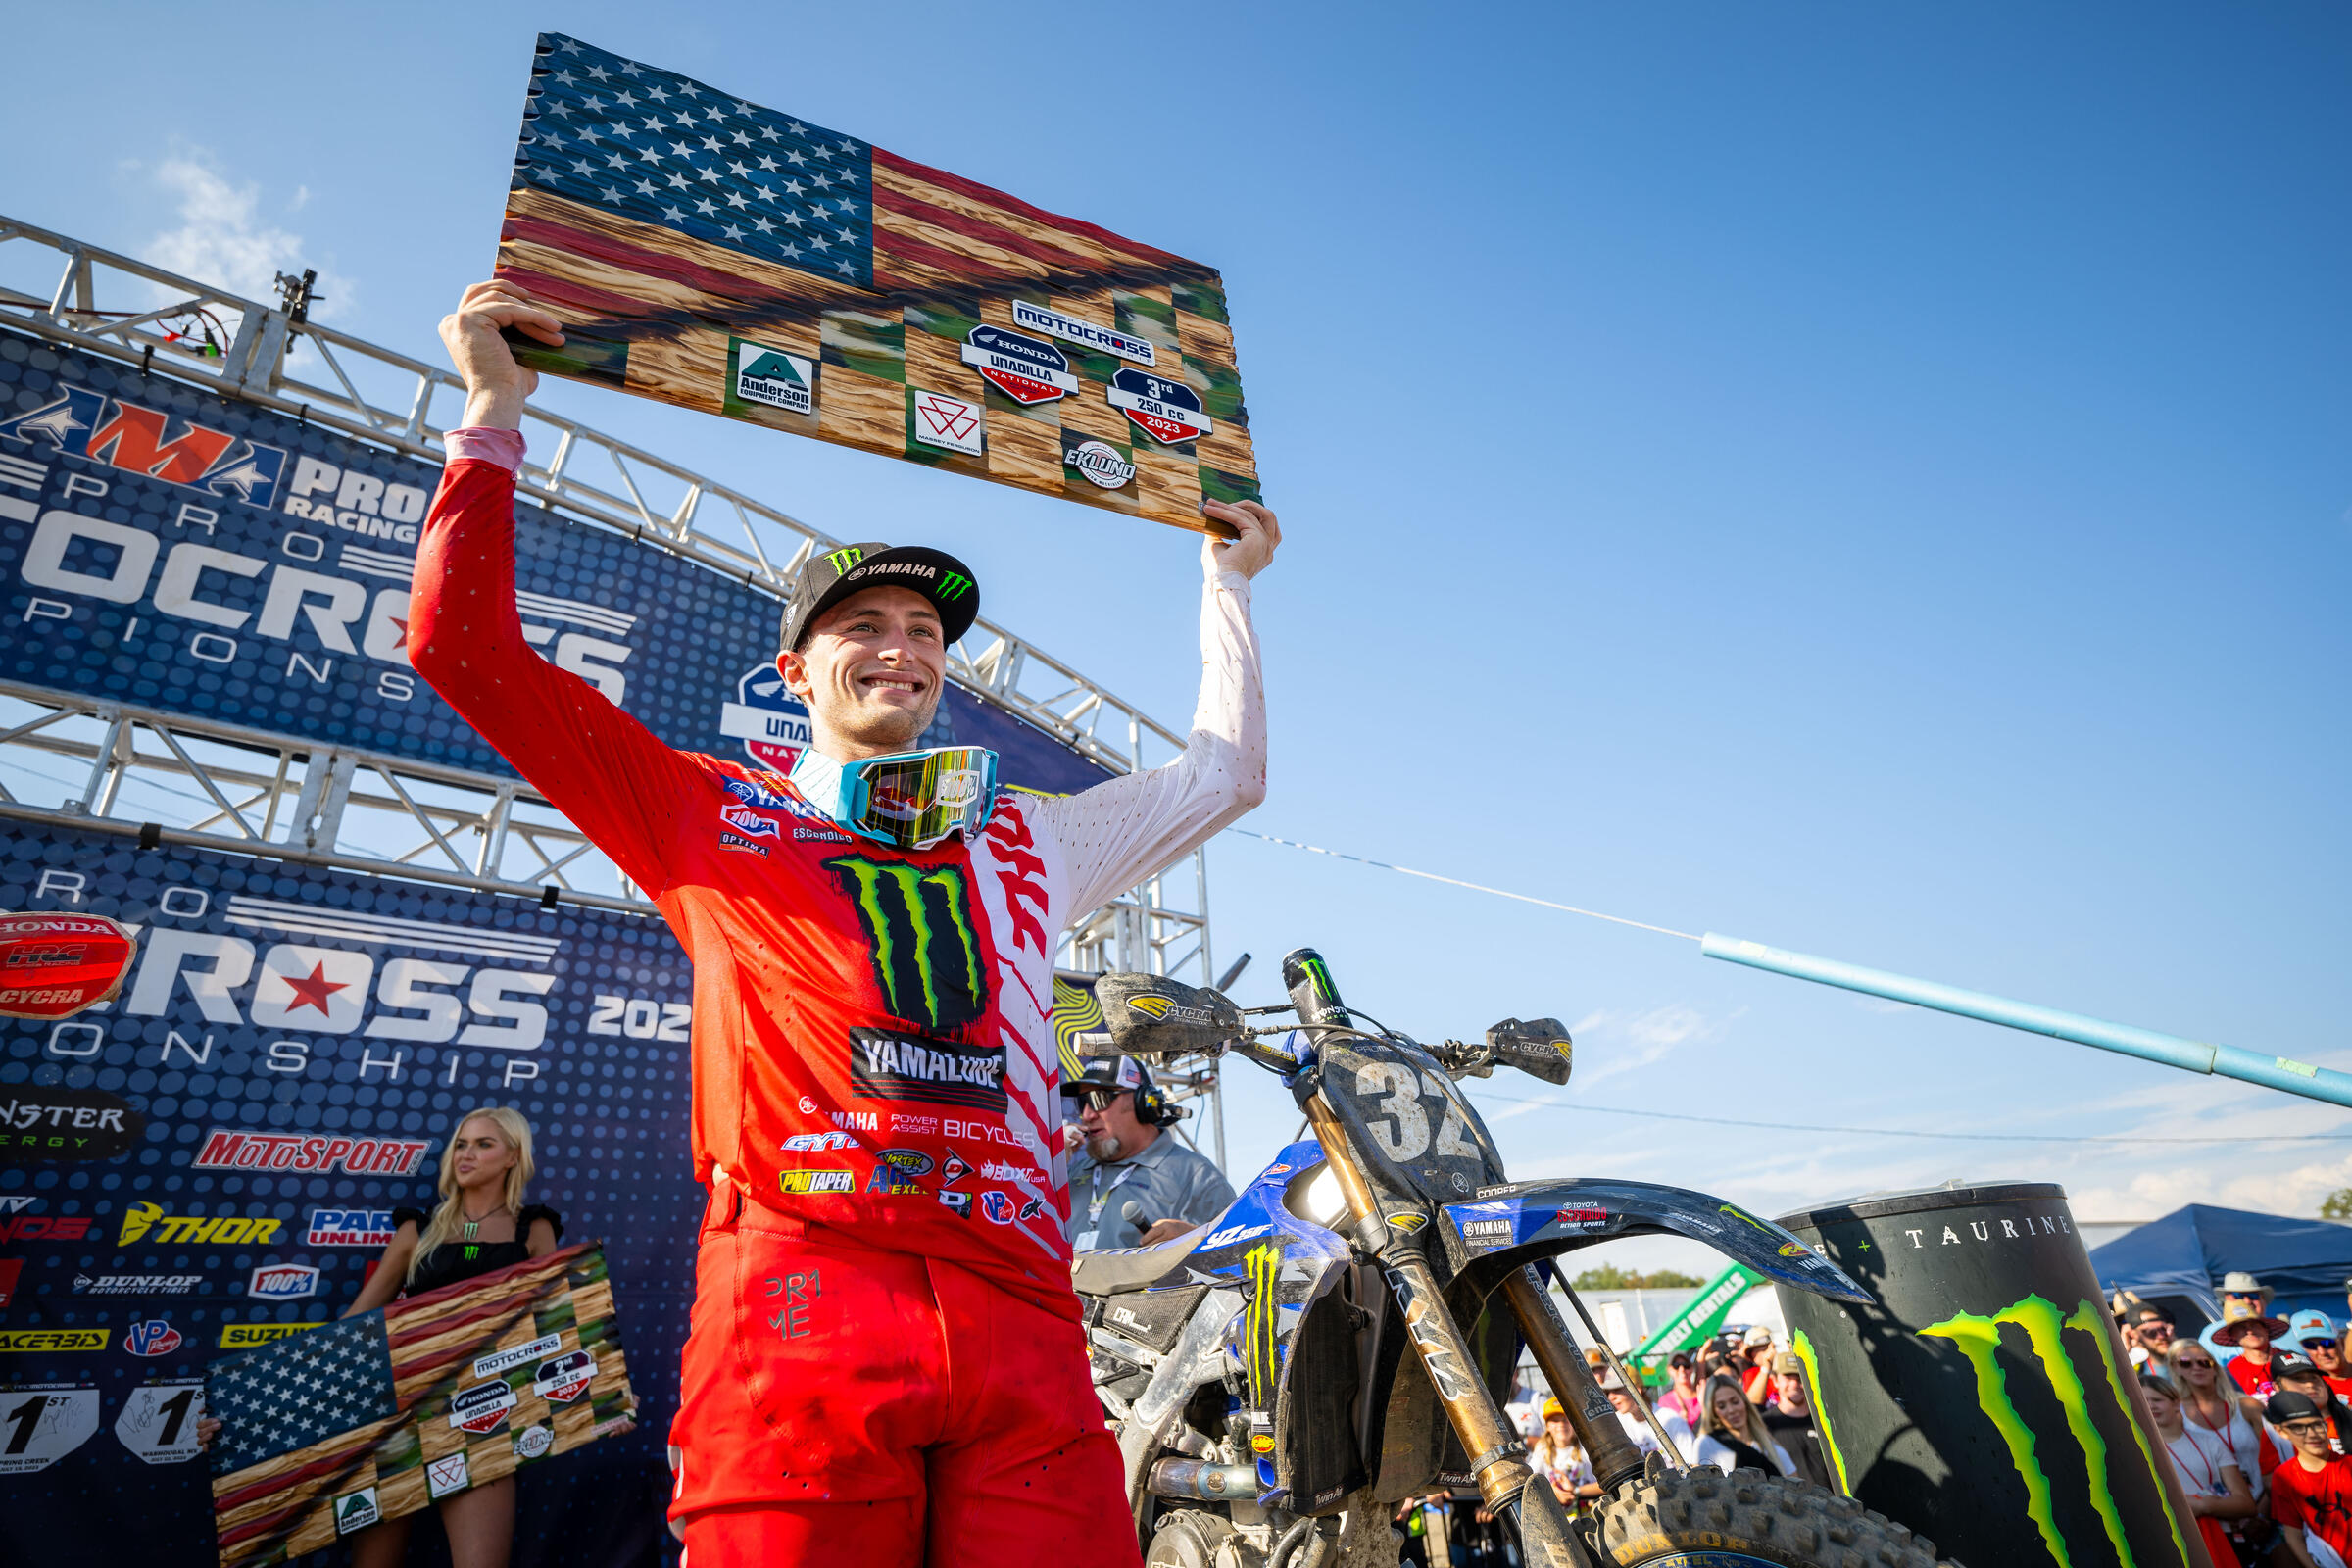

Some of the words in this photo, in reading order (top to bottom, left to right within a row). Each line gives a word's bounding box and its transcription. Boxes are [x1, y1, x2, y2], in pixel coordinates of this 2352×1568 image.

[1017, 307, 1152, 359] MOTOCROSS
[1018, 318, 1153, 365] CHAMPIONSHIP
[997, 338, 1060, 365] HONDA
[990, 354, 1053, 383] UNADILLA
[990, 369, 1054, 393] NATIONAL
[740, 376, 809, 405] Anderson
[740, 388, 777, 405] EQUIPMENT
[777, 395, 809, 411] COMPANY
[1137, 397, 1162, 416] 250
[1146, 416, 1180, 434] 2023
[0, 382, 287, 510] AMA
[946, 441, 981, 455] FERGUSON
[1064, 449, 1137, 480] EKLUND
[291, 456, 428, 523] PRO
[284, 496, 418, 545] RACING
[867, 563, 937, 579] YAMAHA
[0, 493, 633, 706] OCRS
[722, 834, 767, 857] OPTIMA
[980, 794, 1050, 961] THO
[0, 989, 84, 1004] CYCRA
[98, 923, 557, 1051] ROSS
[588, 994, 692, 1043] 202
[1166, 1004, 1212, 1021] CYCRA
[1520, 1041, 1559, 1056] CYCRA
[861, 1039, 1003, 1089] YAMALUBE
[823, 1111, 878, 1132] MAHA
[890, 1113, 939, 1126] POWER
[1355, 1061, 1483, 1163] 32
[890, 1122, 938, 1135] ASSIST
[943, 1118, 1035, 1149] BICYCLES
[884, 1152, 923, 1169] VORTEX
[782, 1171, 852, 1192] PROTAPER
[982, 1192, 1005, 1222] VP
[1556, 1206, 1607, 1223] ESCONDIDO
[156, 1216, 282, 1245] THOR
[312, 1209, 396, 1232] PAR
[1474, 1220, 1512, 1235] YAMAHA
[1905, 1215, 2071, 1249] TAURINE
[93, 1275, 203, 1288] DUNLOP
[259, 1273, 310, 1293] 100%
[1524, 1261, 1558, 1316] racin
[1686, 1271, 1747, 1330] RENTALS
[128, 1321, 168, 1355] VP
[1383, 1264, 1478, 1401] KYB
[477, 1338, 559, 1374] MOTOCROSS
[467, 1386, 507, 1404] HONDA
[557, 1383, 579, 1396] 2023
[1439, 1471, 1461, 1483] Twin
[1315, 1490, 1334, 1506] Twin
